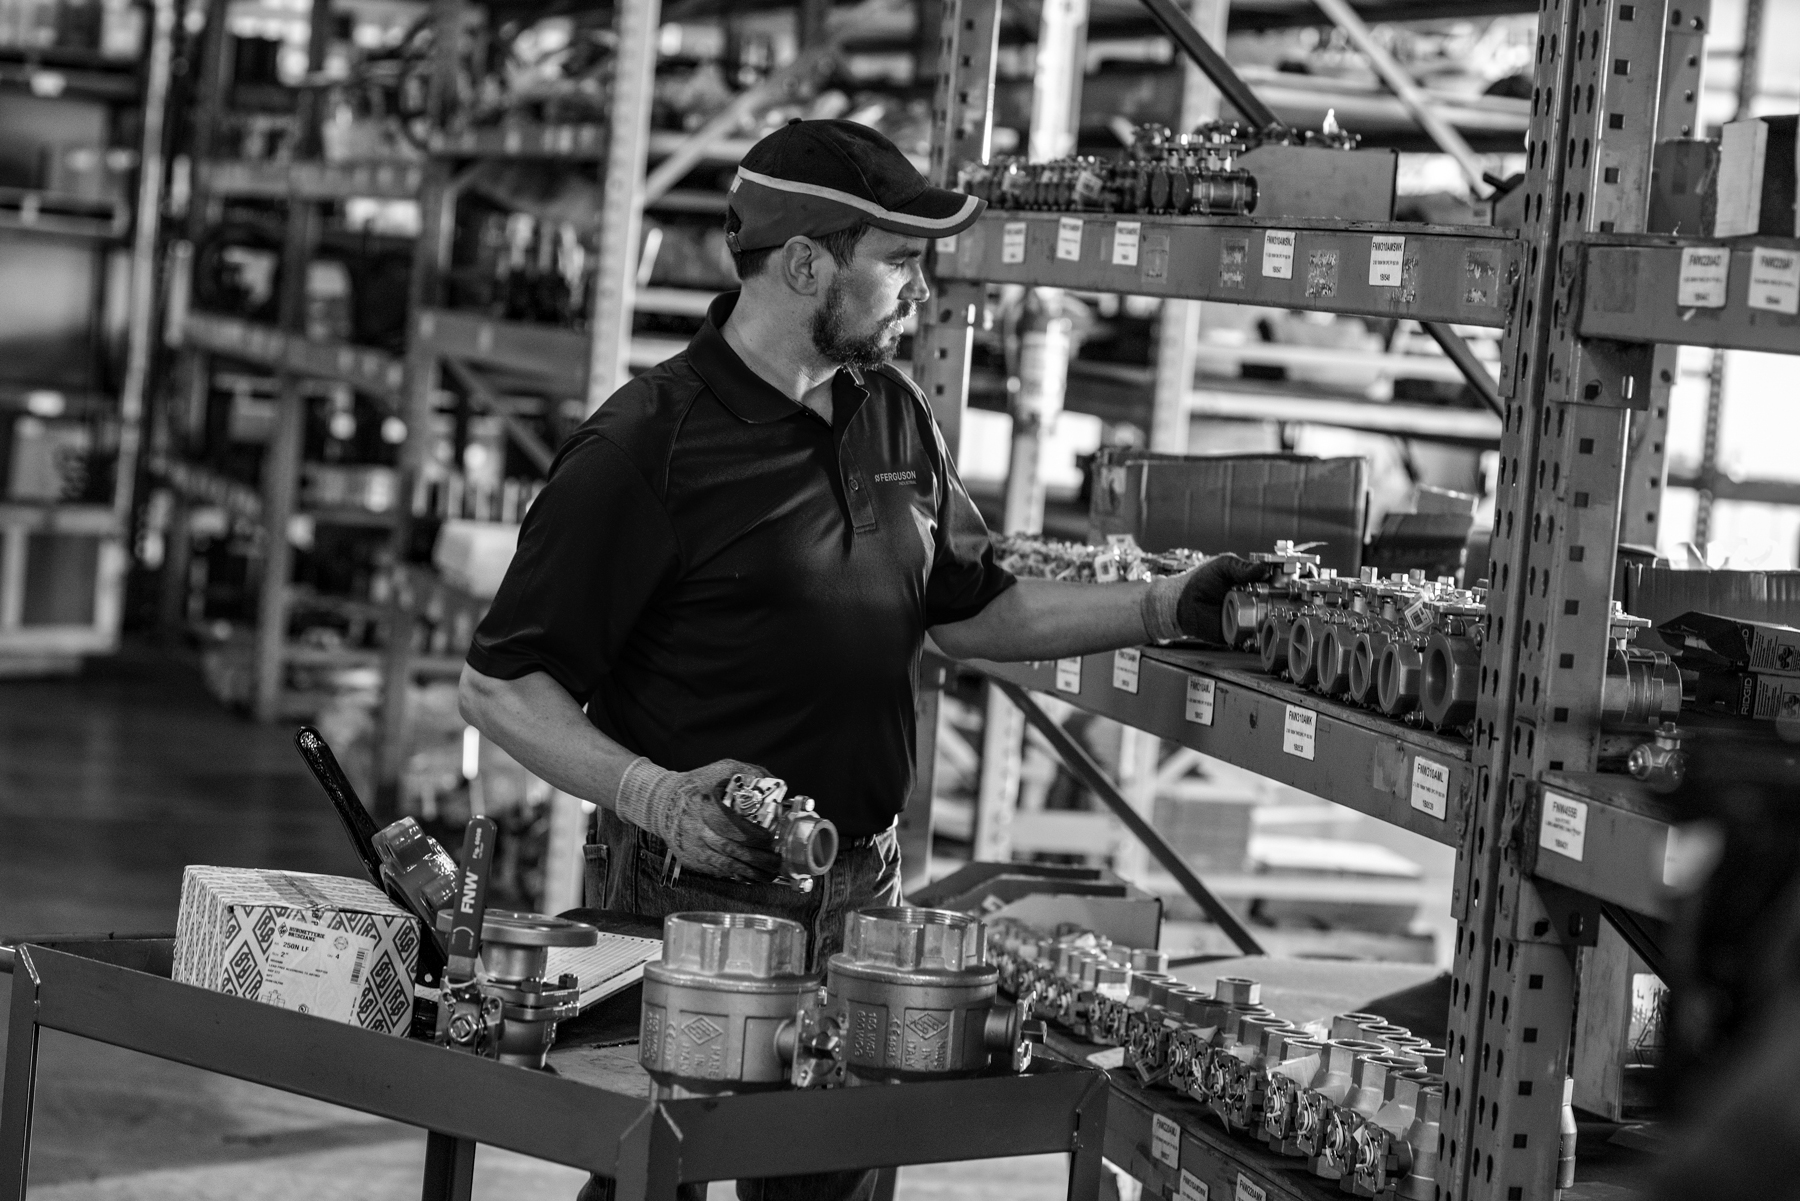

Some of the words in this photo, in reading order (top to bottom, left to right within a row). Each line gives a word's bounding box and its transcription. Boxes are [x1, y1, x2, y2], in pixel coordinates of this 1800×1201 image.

[880, 471, 916, 481] FERGUSON
[1741, 677, 1752, 715] RIDGID
[461, 872, 478, 913] FNW
[283, 941, 300, 952] 250N
[301, 945, 310, 953] LF
[680, 1042, 691, 1075] ITALY
[695, 1053, 705, 1067] IN
[709, 1045, 721, 1077] MADE
[905, 1039, 917, 1068] ITALY
[921, 1047, 932, 1060] IN
[934, 1039, 947, 1069] MADE
